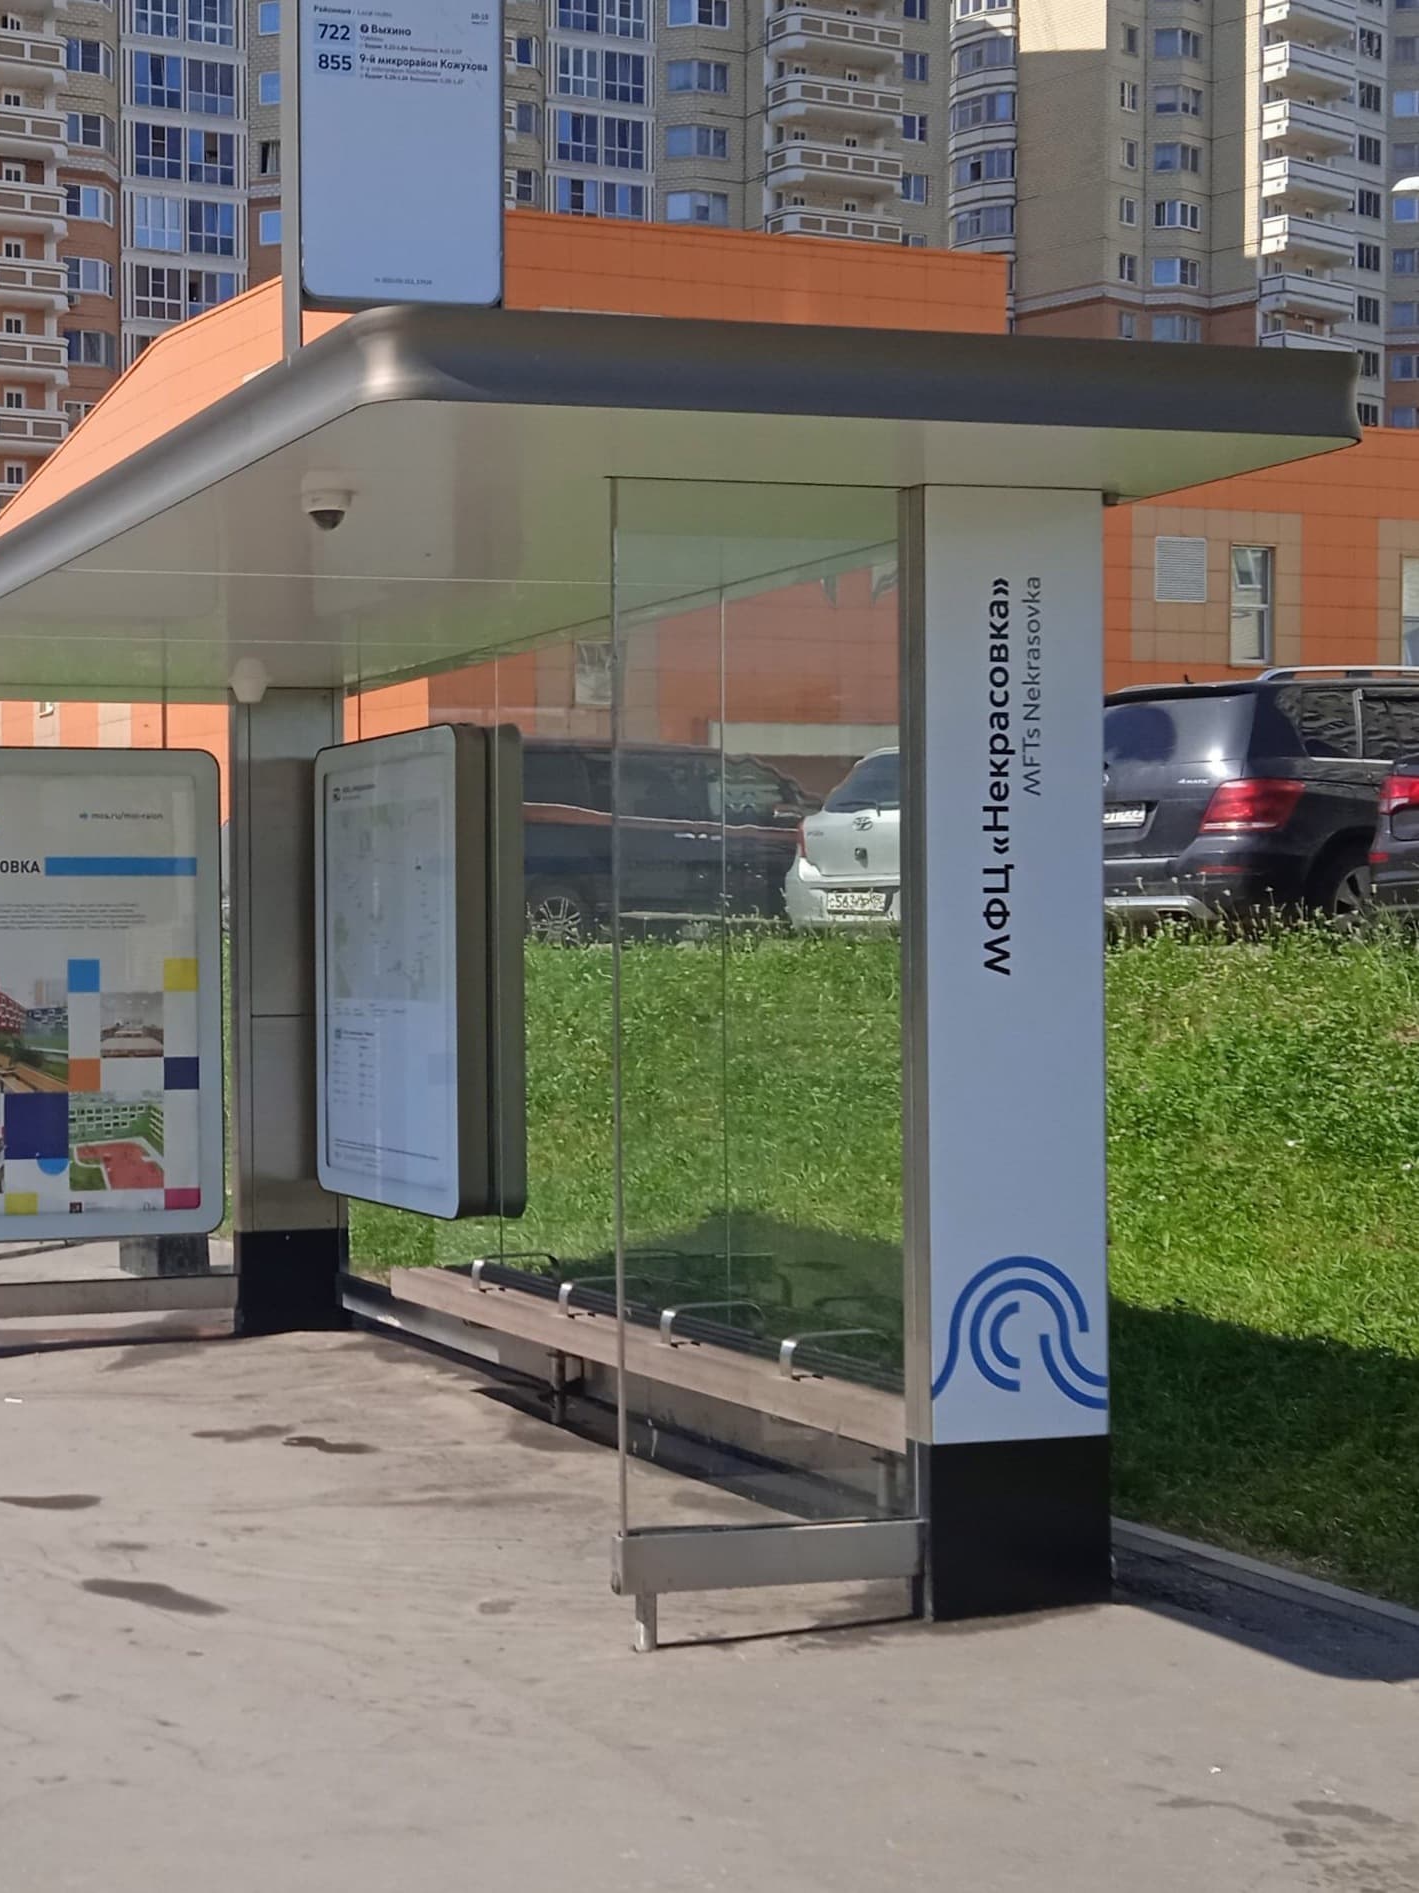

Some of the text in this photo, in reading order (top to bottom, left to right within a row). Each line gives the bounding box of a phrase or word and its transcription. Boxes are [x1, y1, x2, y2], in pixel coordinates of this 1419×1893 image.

[318, 23, 350, 41] 722
[371, 24, 412, 36] Выхино
[318, 53, 352, 71] 855
[359, 53, 376, 64] 9-й
[377, 55, 438, 69] микрорайон
[440, 59, 488, 73] Кожухова
[1021, 576, 1041, 796] MFTs Nekrasovka
[982, 577, 1016, 976] МФЦ «Некрасовка»
